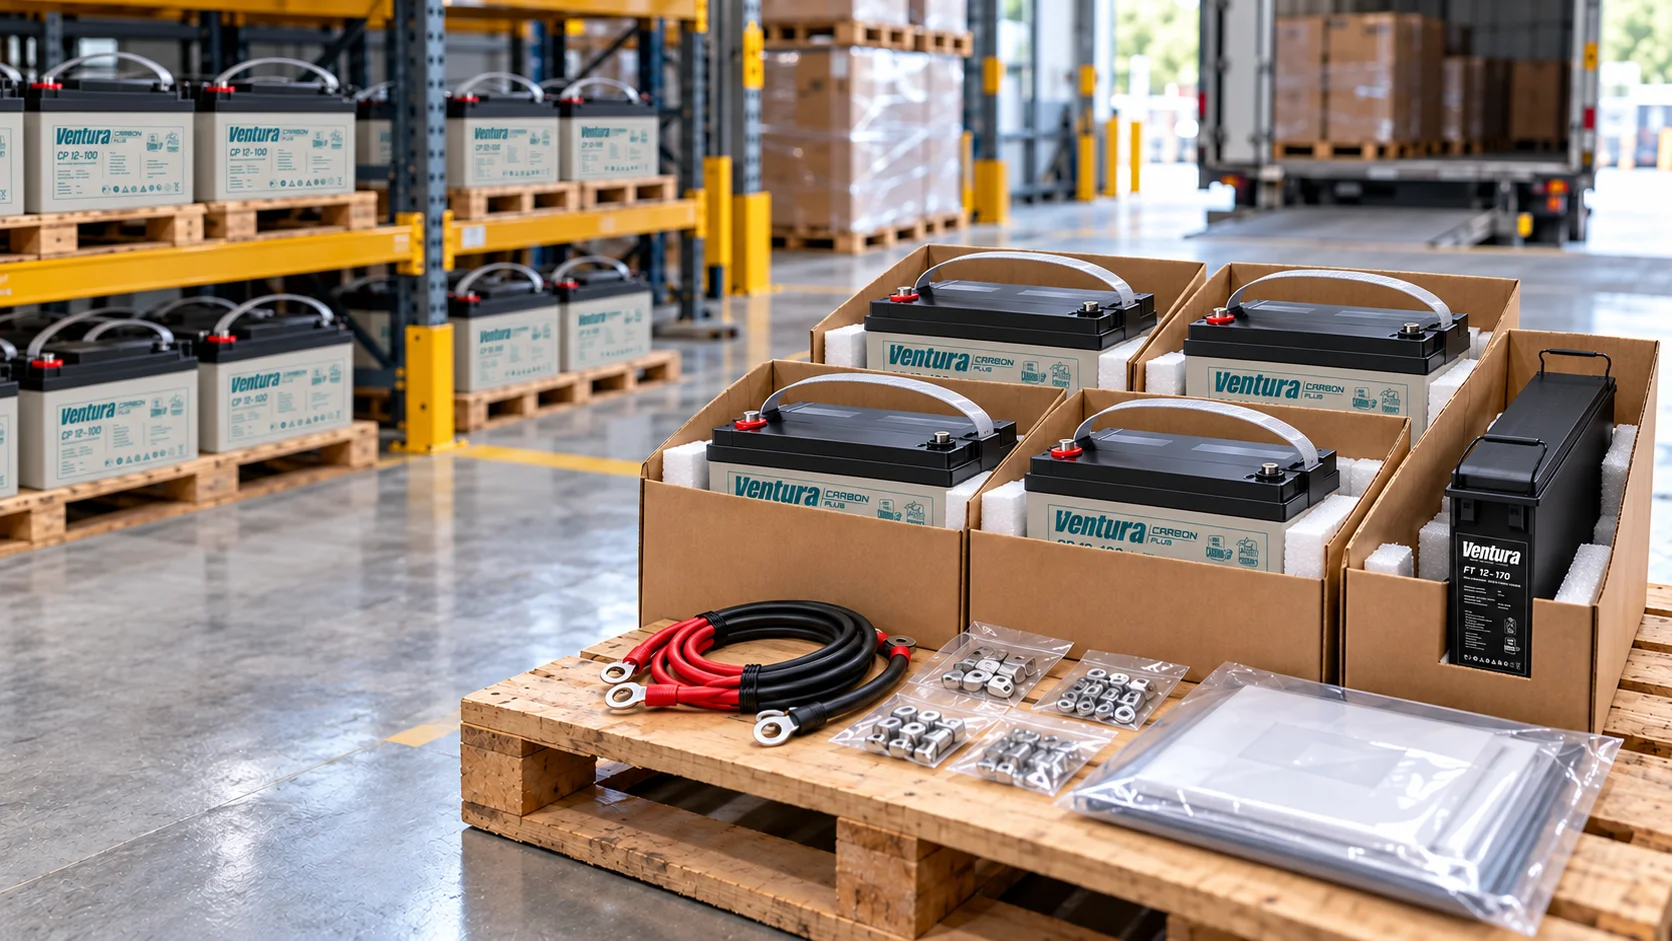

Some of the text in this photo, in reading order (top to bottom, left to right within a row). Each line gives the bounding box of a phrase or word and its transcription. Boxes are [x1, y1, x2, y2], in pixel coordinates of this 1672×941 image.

[56, 127, 111, 145] Ventura
[229, 126, 280, 143] Ventura
[474, 127, 508, 140] Ventura
[581, 126, 610, 138] Ventura
[57, 151, 98, 161] CP 12-100
[230, 148, 268, 157] CP 12-100
[890, 344, 1014, 371] Ventura CARBON
[231, 372, 280, 393] Ventura
[1215, 371, 1344, 399] Ventura CARBON
[61, 402, 116, 425] Ventura
[61, 430, 73, 440] CP
[74, 426, 102, 438] 12-100
[735, 475, 870, 507] Ventura CARBON
[1055, 510, 1198, 544] Ventura CARBON
[1463, 541, 1521, 565] Ventura
[1463, 566, 1511, 580] FT 12-170
